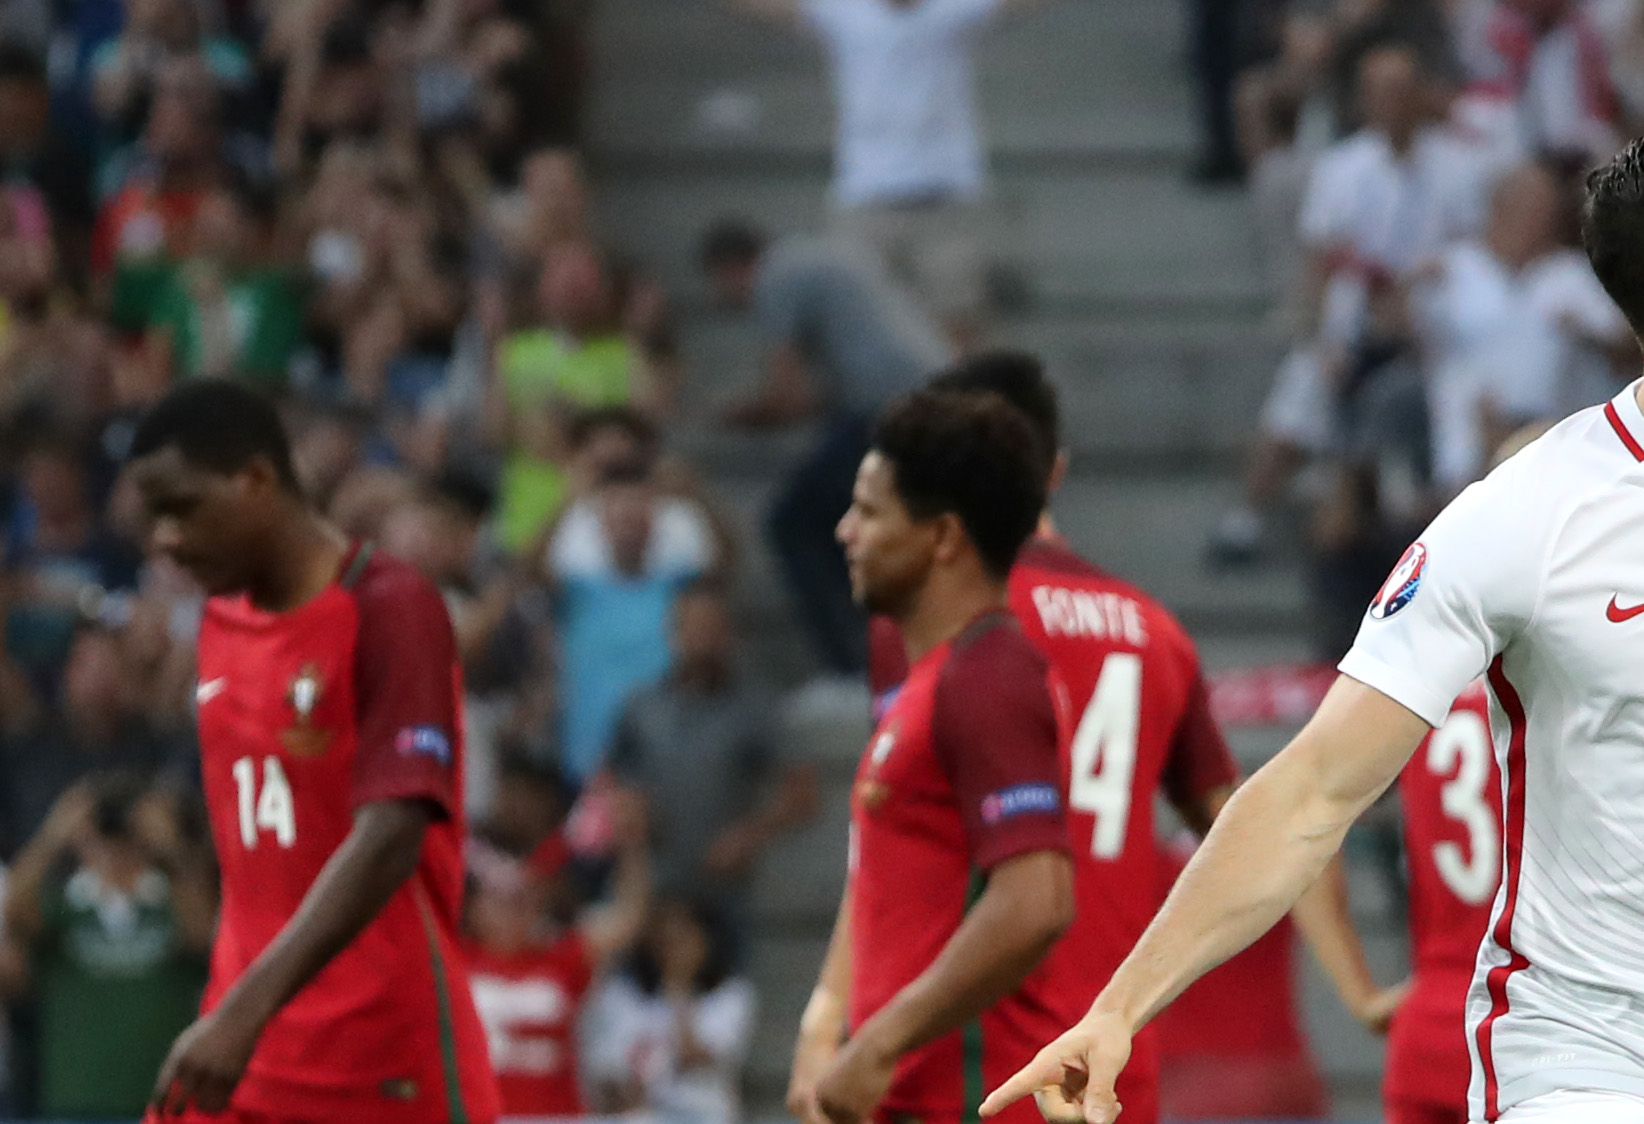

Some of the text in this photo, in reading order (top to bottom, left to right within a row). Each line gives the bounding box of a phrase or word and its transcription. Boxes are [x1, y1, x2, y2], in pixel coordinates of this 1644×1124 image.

[1032, 585, 1149, 648] FONTE
[232, 754, 298, 851] 14
[1069, 652, 1144, 861] 4
[1426, 708, 1500, 906] 3
